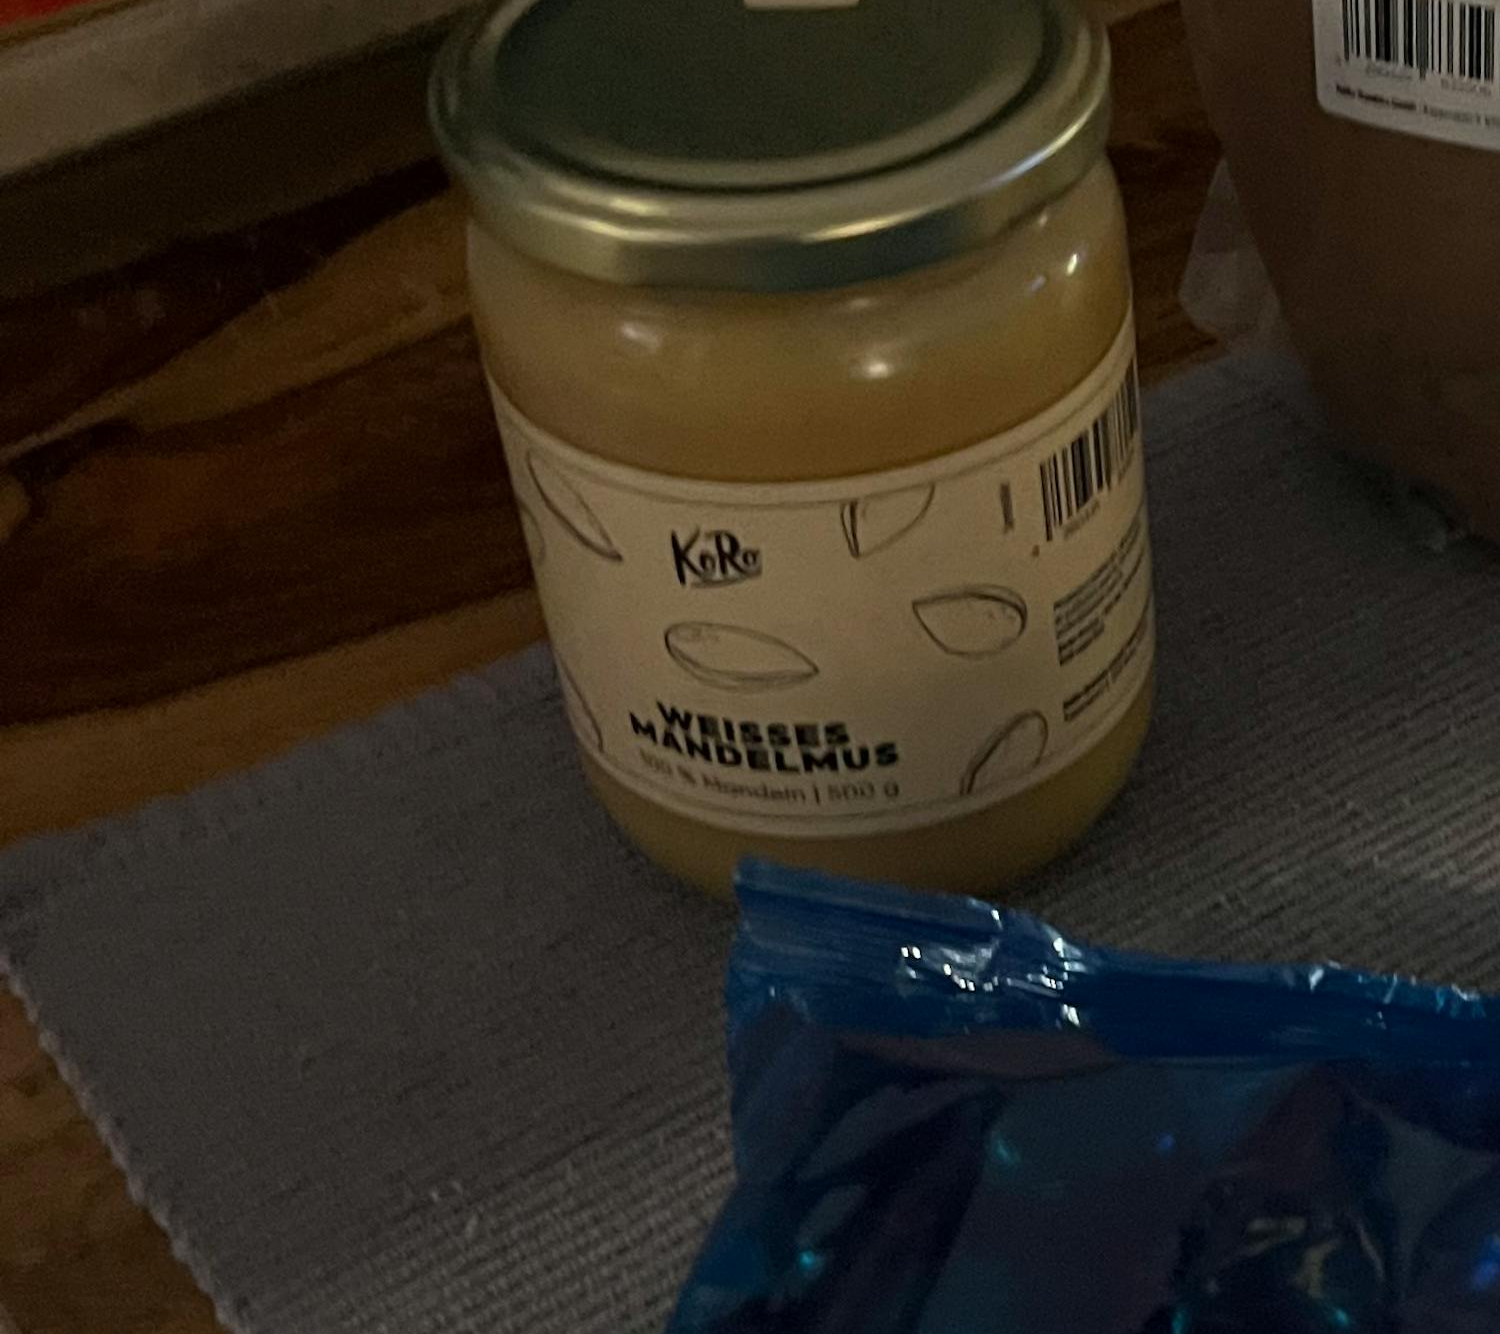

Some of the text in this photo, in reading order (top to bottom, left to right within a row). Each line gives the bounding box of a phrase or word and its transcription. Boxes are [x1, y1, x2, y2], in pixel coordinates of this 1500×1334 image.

[671, 526, 762, 589] KoRo
[629, 712, 899, 773] MANDELMUS
[656, 700, 850, 746] WEISSES
